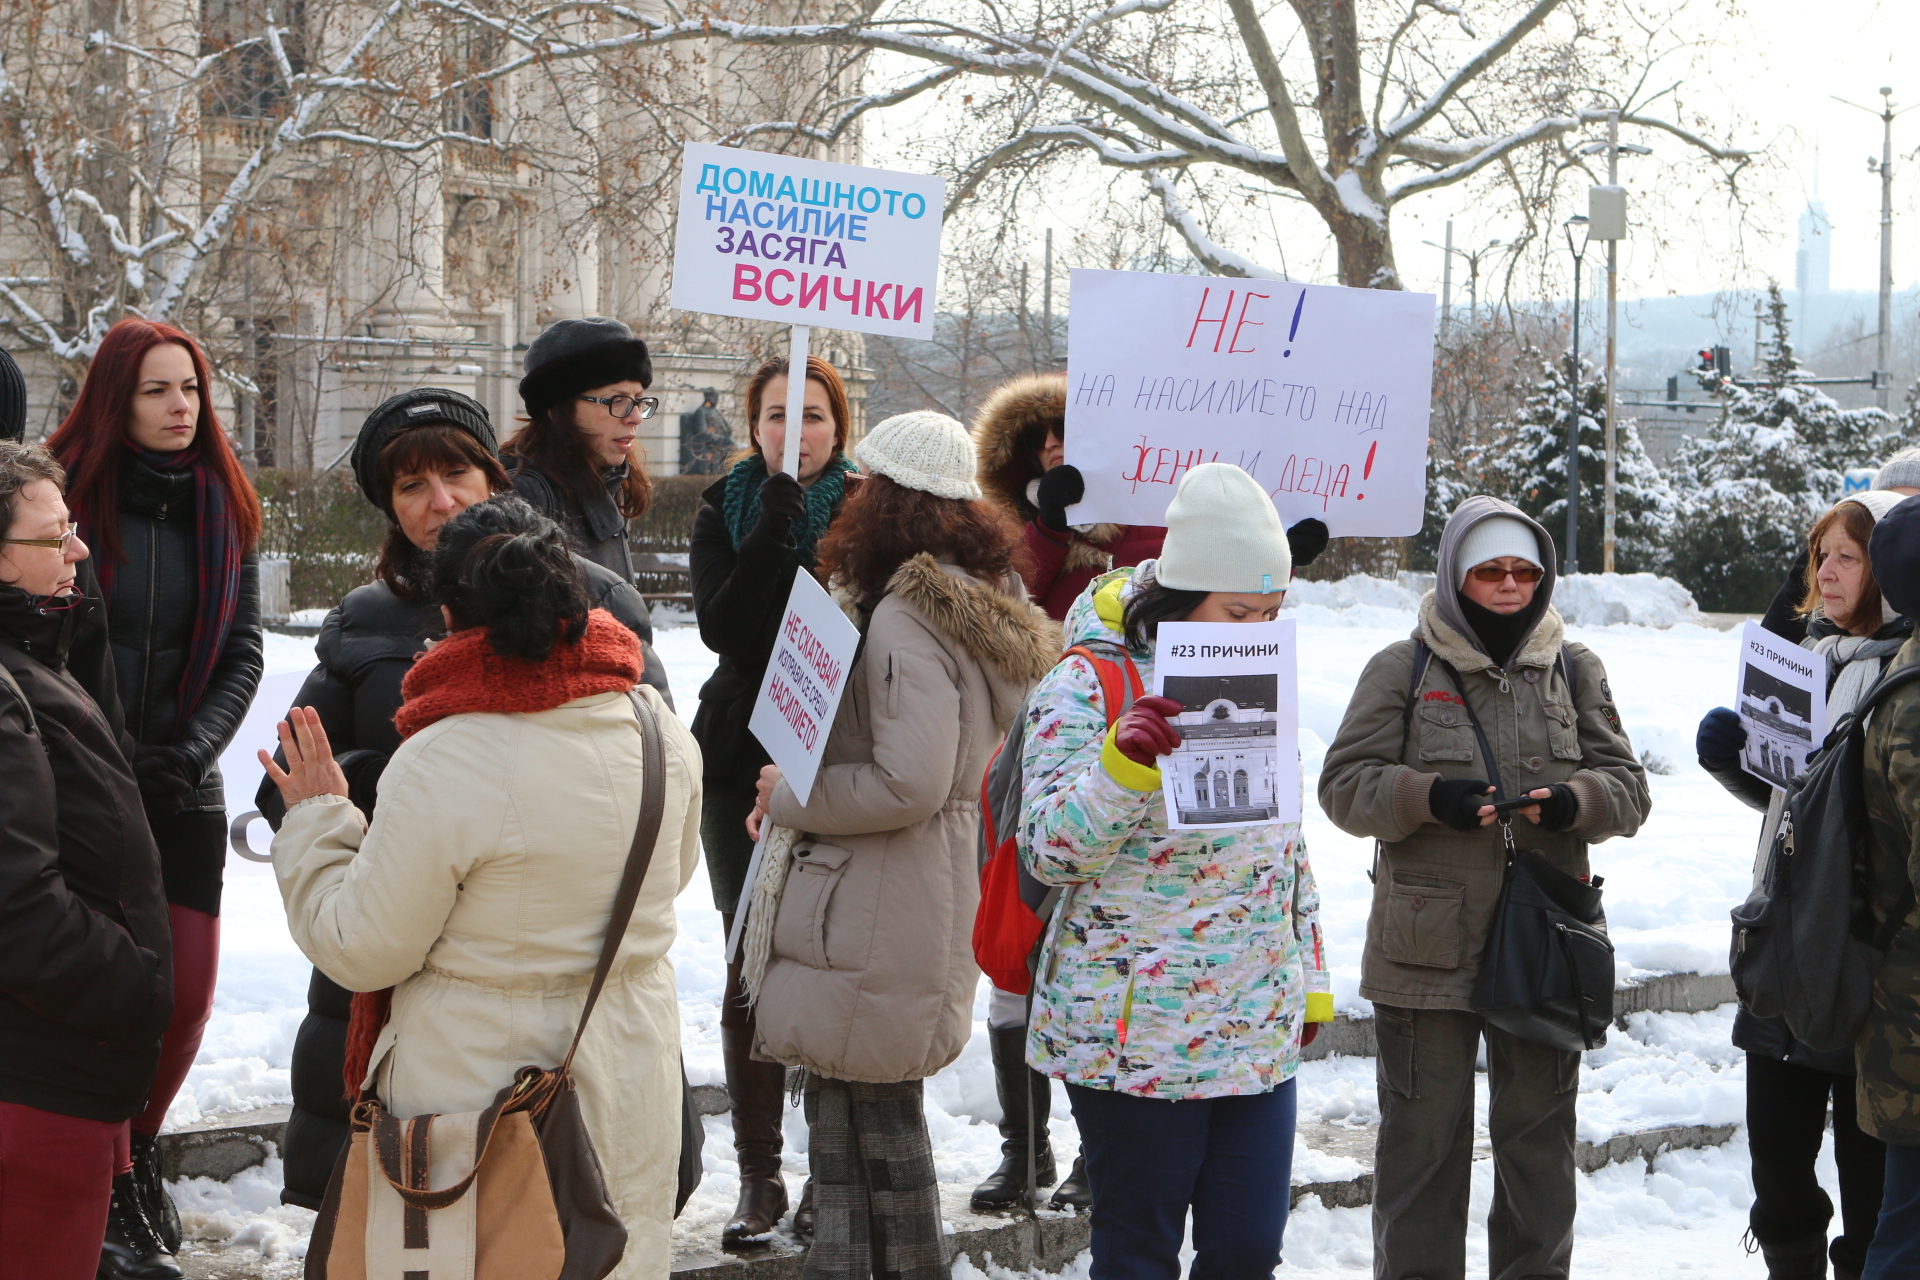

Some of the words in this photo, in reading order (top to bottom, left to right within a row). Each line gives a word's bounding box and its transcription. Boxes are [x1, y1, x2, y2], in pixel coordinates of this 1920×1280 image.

[696, 163, 926, 219] ДОМАШНОТО
[705, 194, 868, 242] НАСИЛИЕ
[715, 226, 847, 269] ЗАСЯГА
[732, 263, 923, 323] ВСИЧКИ
[1075, 372, 1116, 407] НА
[1134, 376, 1317, 421] НАСИЛИЕТО
[1335, 390, 1388, 435] НАД
[784, 610, 801, 643] НЕ
[798, 626, 842, 695] СКАТАВАЙ!
[1171, 645, 1196, 658] #23
[1201, 644, 1279, 658] ПРИЧИНИ
[1750, 640, 1765, 656] #23
[1767, 649, 1813, 678] ПРИЧИНИ
[777, 646, 804, 688] ИЗПРАВИ
[801, 676, 811, 697] СЕ
[809, 685, 829, 722] СРЕЩУ
[768, 672, 819, 756] НАСИЛИЕТО!
